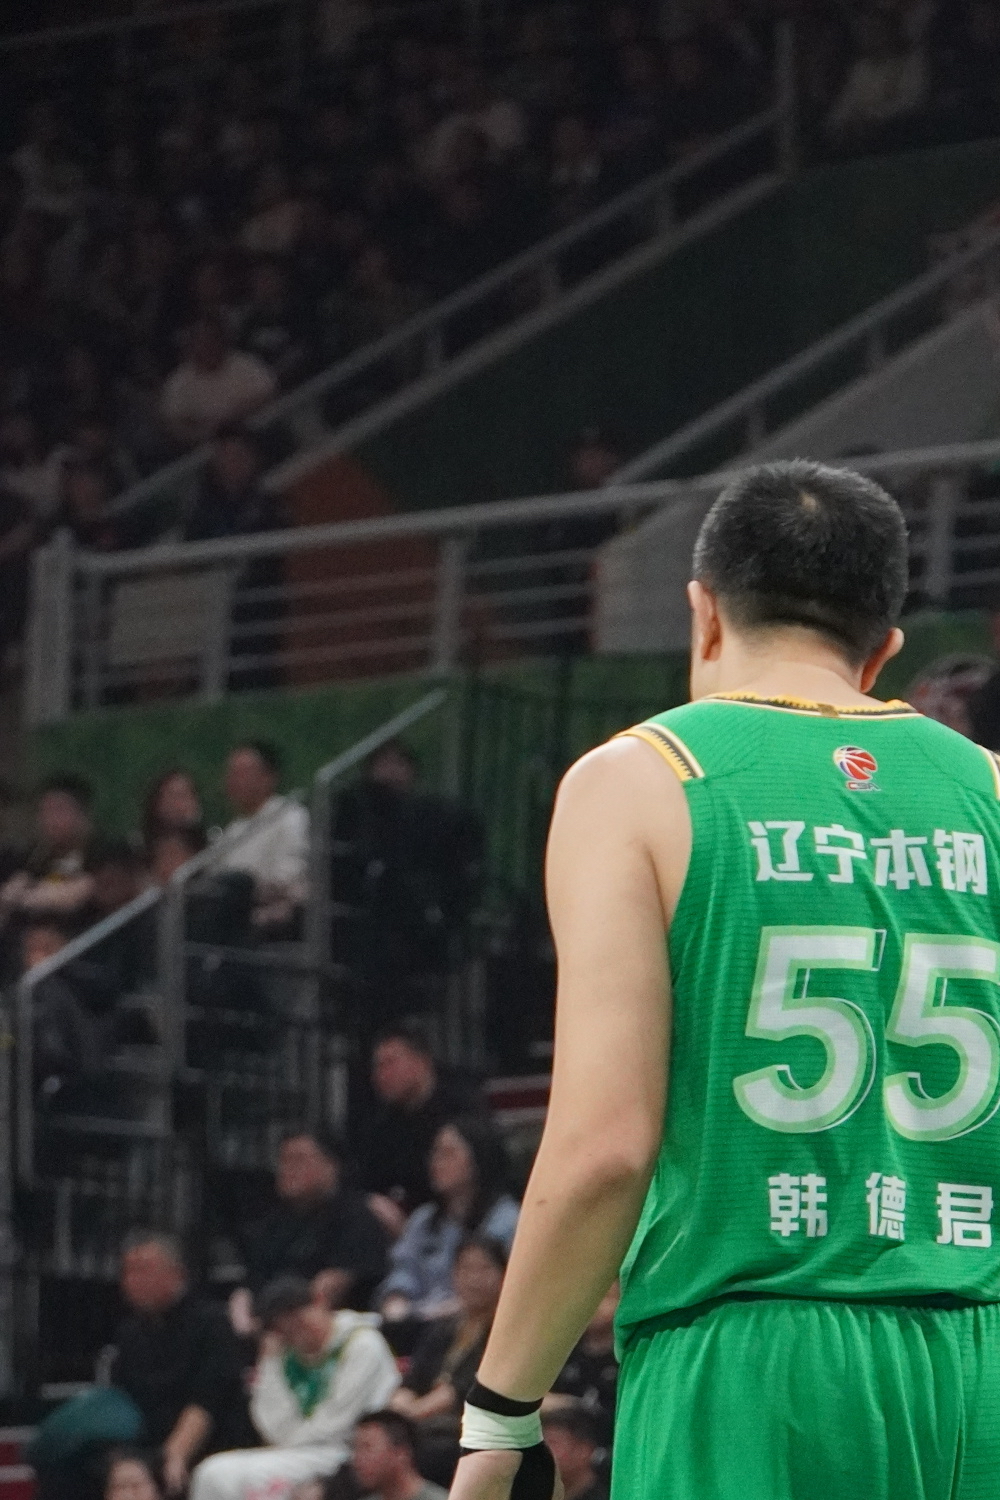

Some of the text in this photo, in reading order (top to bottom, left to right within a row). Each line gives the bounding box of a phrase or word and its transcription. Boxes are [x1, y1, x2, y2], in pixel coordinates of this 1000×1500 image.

[750, 820, 988, 895] 辽宁本钢
[768, 1172, 994, 1248] 韩德君
